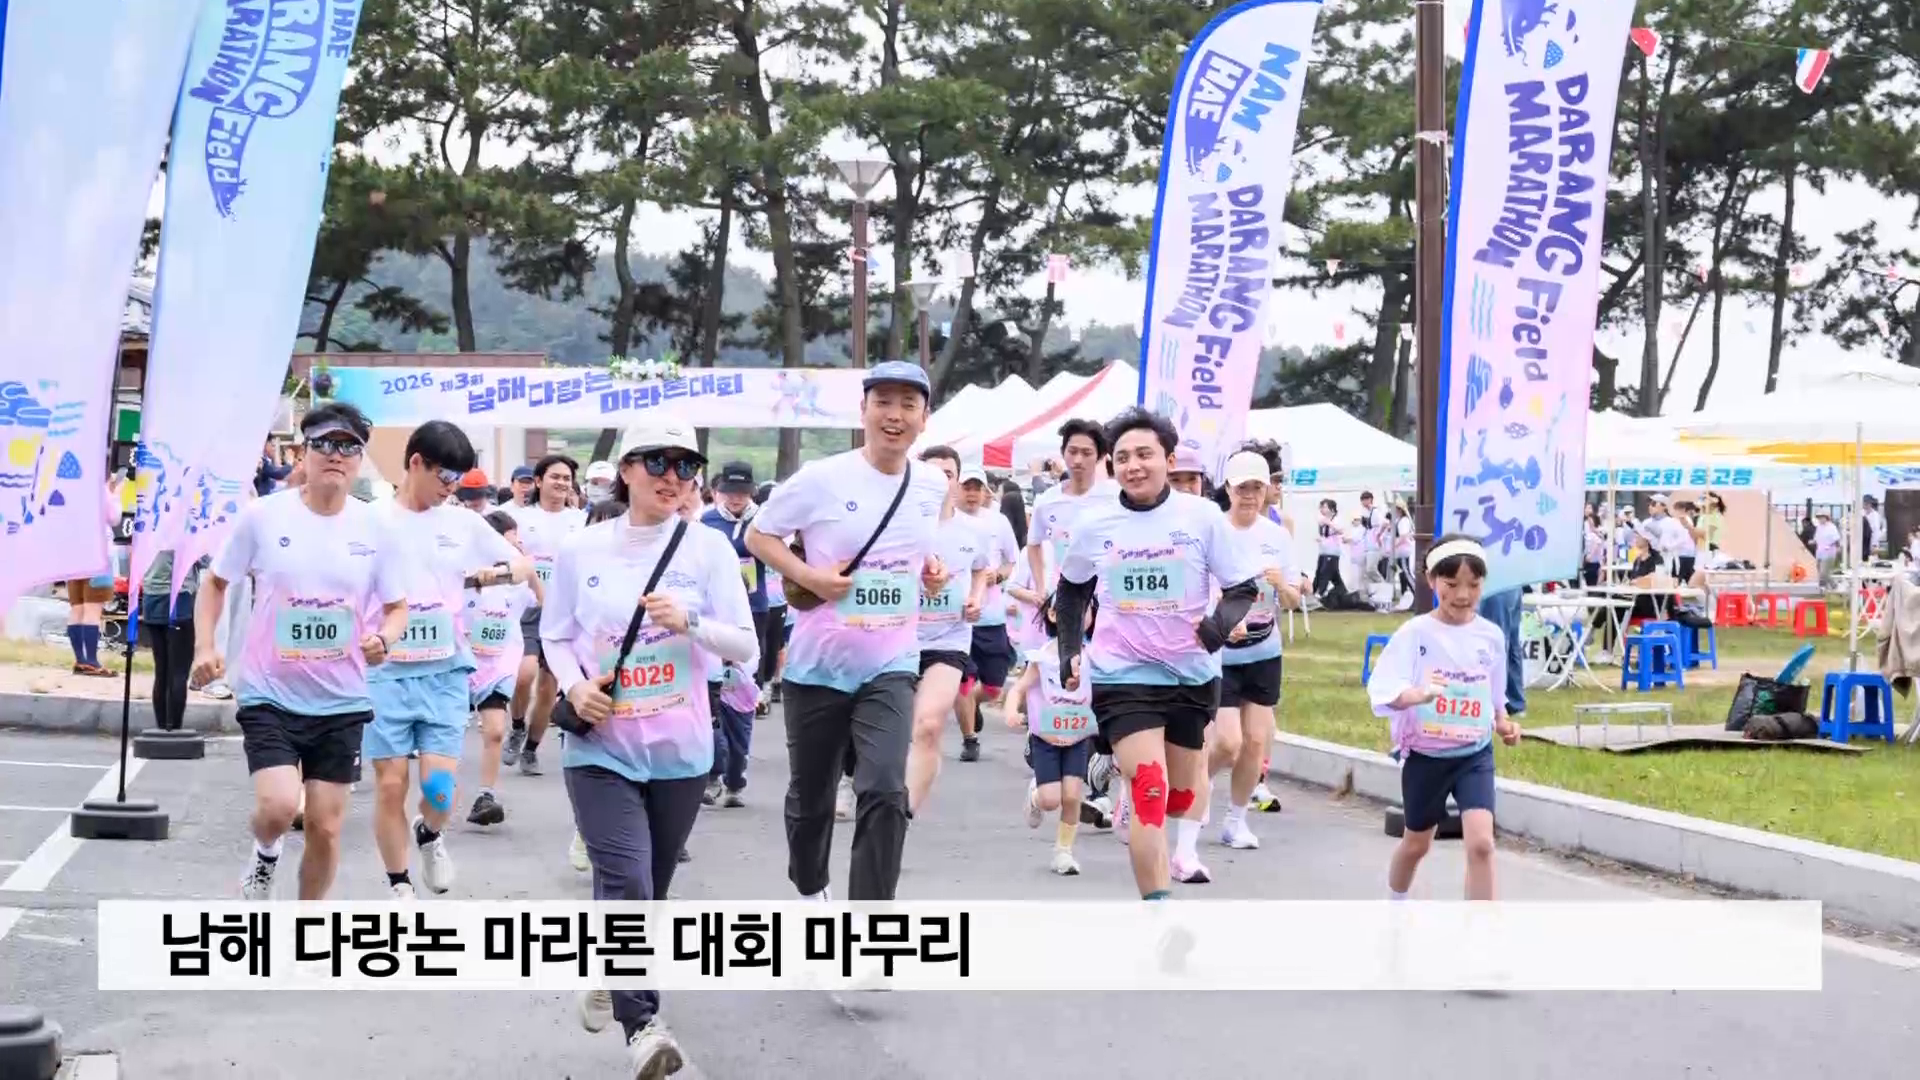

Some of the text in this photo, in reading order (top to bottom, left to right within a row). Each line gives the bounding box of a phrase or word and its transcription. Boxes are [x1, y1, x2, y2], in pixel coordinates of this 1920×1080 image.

[1187, 54, 1243, 125] HAE
[1231, 42, 1301, 134] NAM
[207, 109, 255, 185] Field
[1473, 80, 1554, 269] MARATHON
[1535, 72, 1596, 277] DARANG
[1162, 192, 1225, 329] MARATHON
[1208, 184, 1269, 334] DARANG
[1512, 277, 1564, 383] Field
[380, 372, 434, 395] 2026
[1191, 334, 1233, 411] Field
[855, 588, 902, 606] 5066
[1123, 574, 1169, 591] 5184
[291, 623, 337, 640] 5100
[620, 662, 675, 689] 6029
[1436, 697, 1481, 718] 6128
[1053, 716, 1088, 730] 6127
